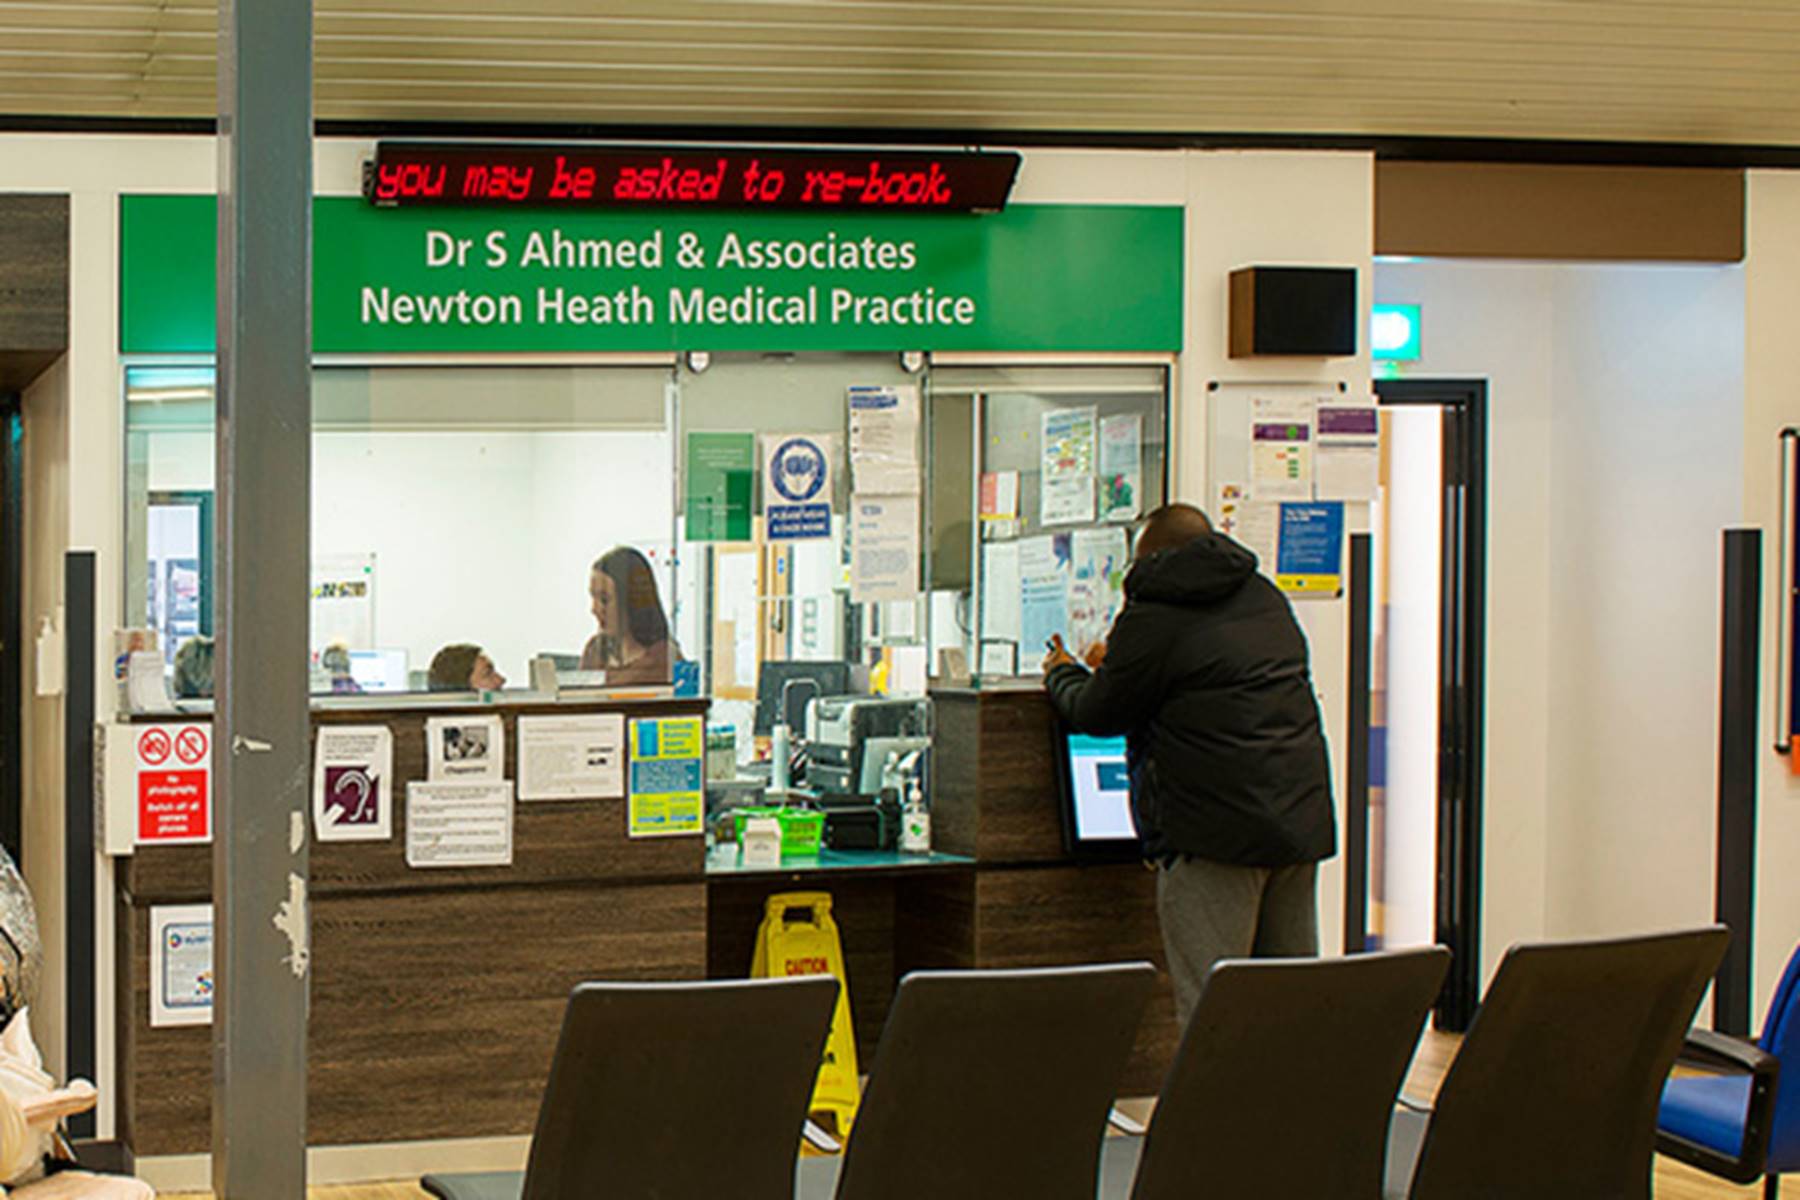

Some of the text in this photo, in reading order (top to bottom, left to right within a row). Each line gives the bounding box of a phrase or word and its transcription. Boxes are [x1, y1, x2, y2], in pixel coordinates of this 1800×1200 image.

[376, 163, 447, 199] you
[463, 165, 534, 201] may
[548, 156, 597, 199] be
[613, 158, 727, 201] asked
[743, 160, 785, 201] to
[426, 229, 916, 270] Dr S Ahmed & Associates
[362, 285, 975, 325] Newton Heath Medical Practice
[784, 957, 829, 976] CAUTION
